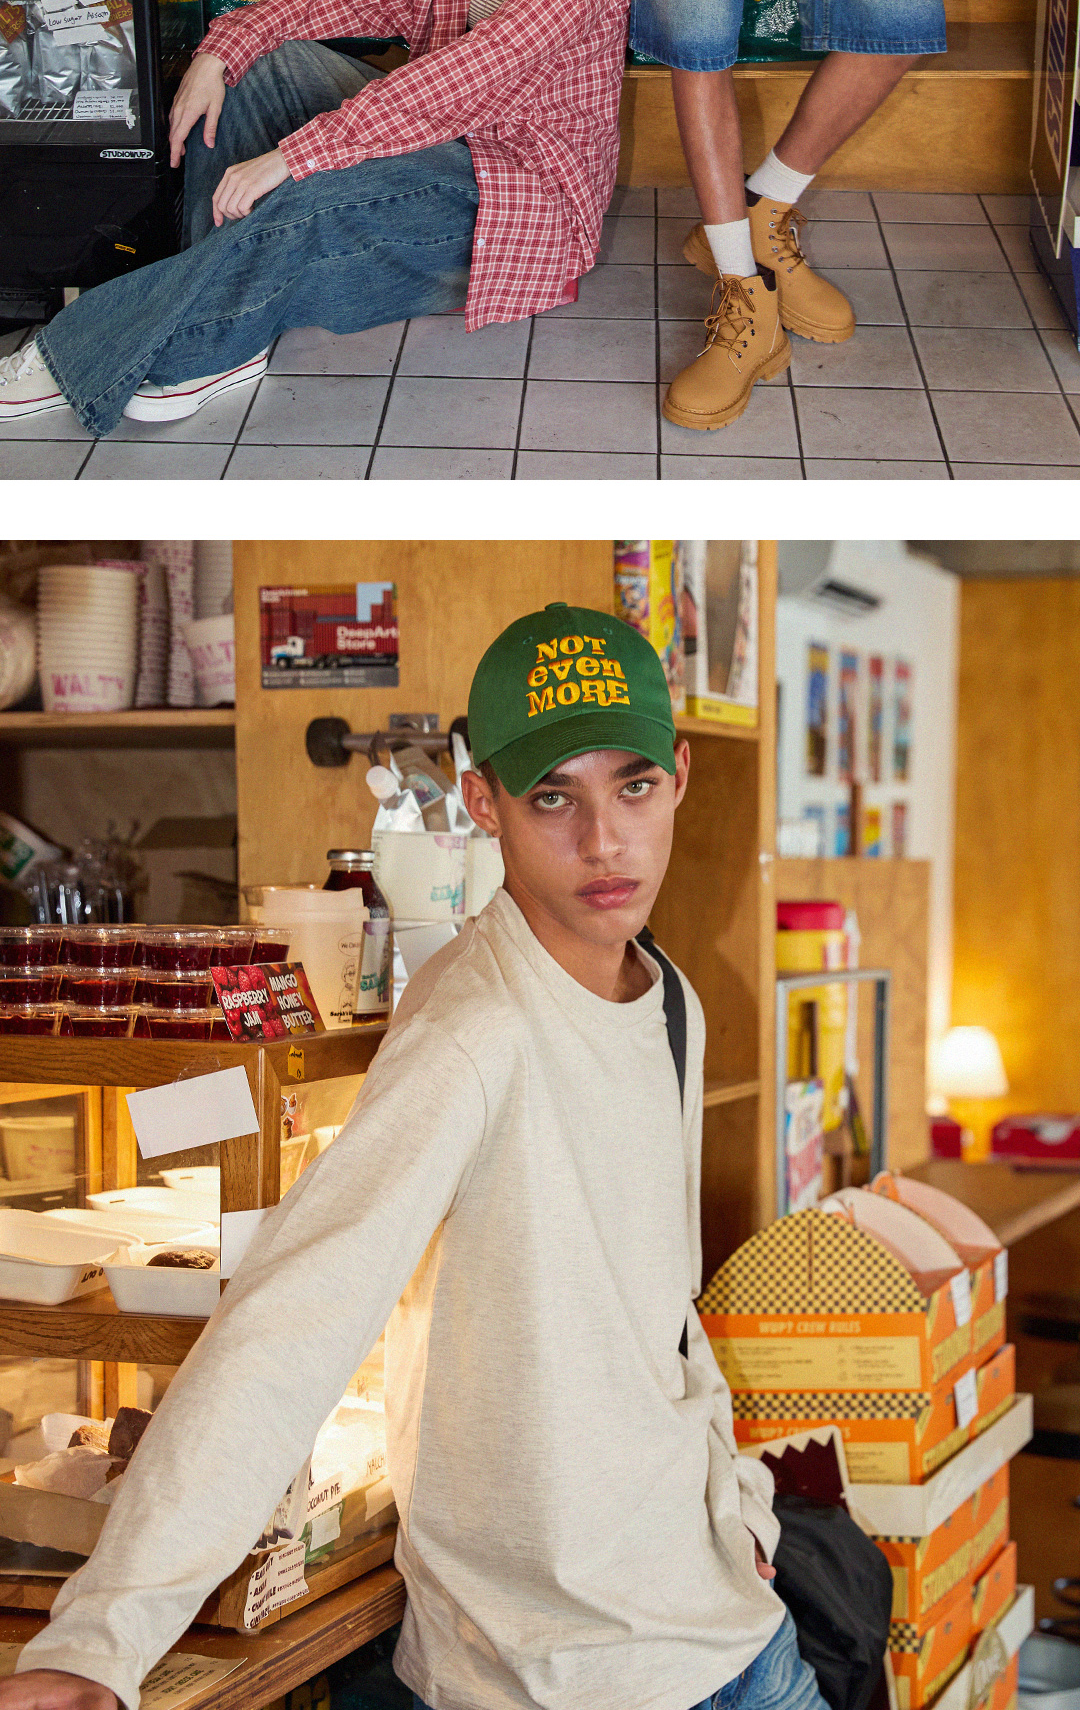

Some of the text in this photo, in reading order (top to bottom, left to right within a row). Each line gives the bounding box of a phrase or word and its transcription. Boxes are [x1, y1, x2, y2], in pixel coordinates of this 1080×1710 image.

[48, 17, 60, 27] Low
[102, 150, 152, 159] STUDIOWUP?
[337, 638, 375, 651] Store
[536, 635, 606, 663] NOT
[527, 656, 625, 687] even
[526, 679, 630, 718] MORE
[268, 973, 298, 991] MANGO
[221, 990, 270, 1010] RASPBERRY
[276, 992, 304, 1011] HONEY
[244, 1012, 262, 1028] JAM
[282, 1012, 314, 1029] BUTTER
